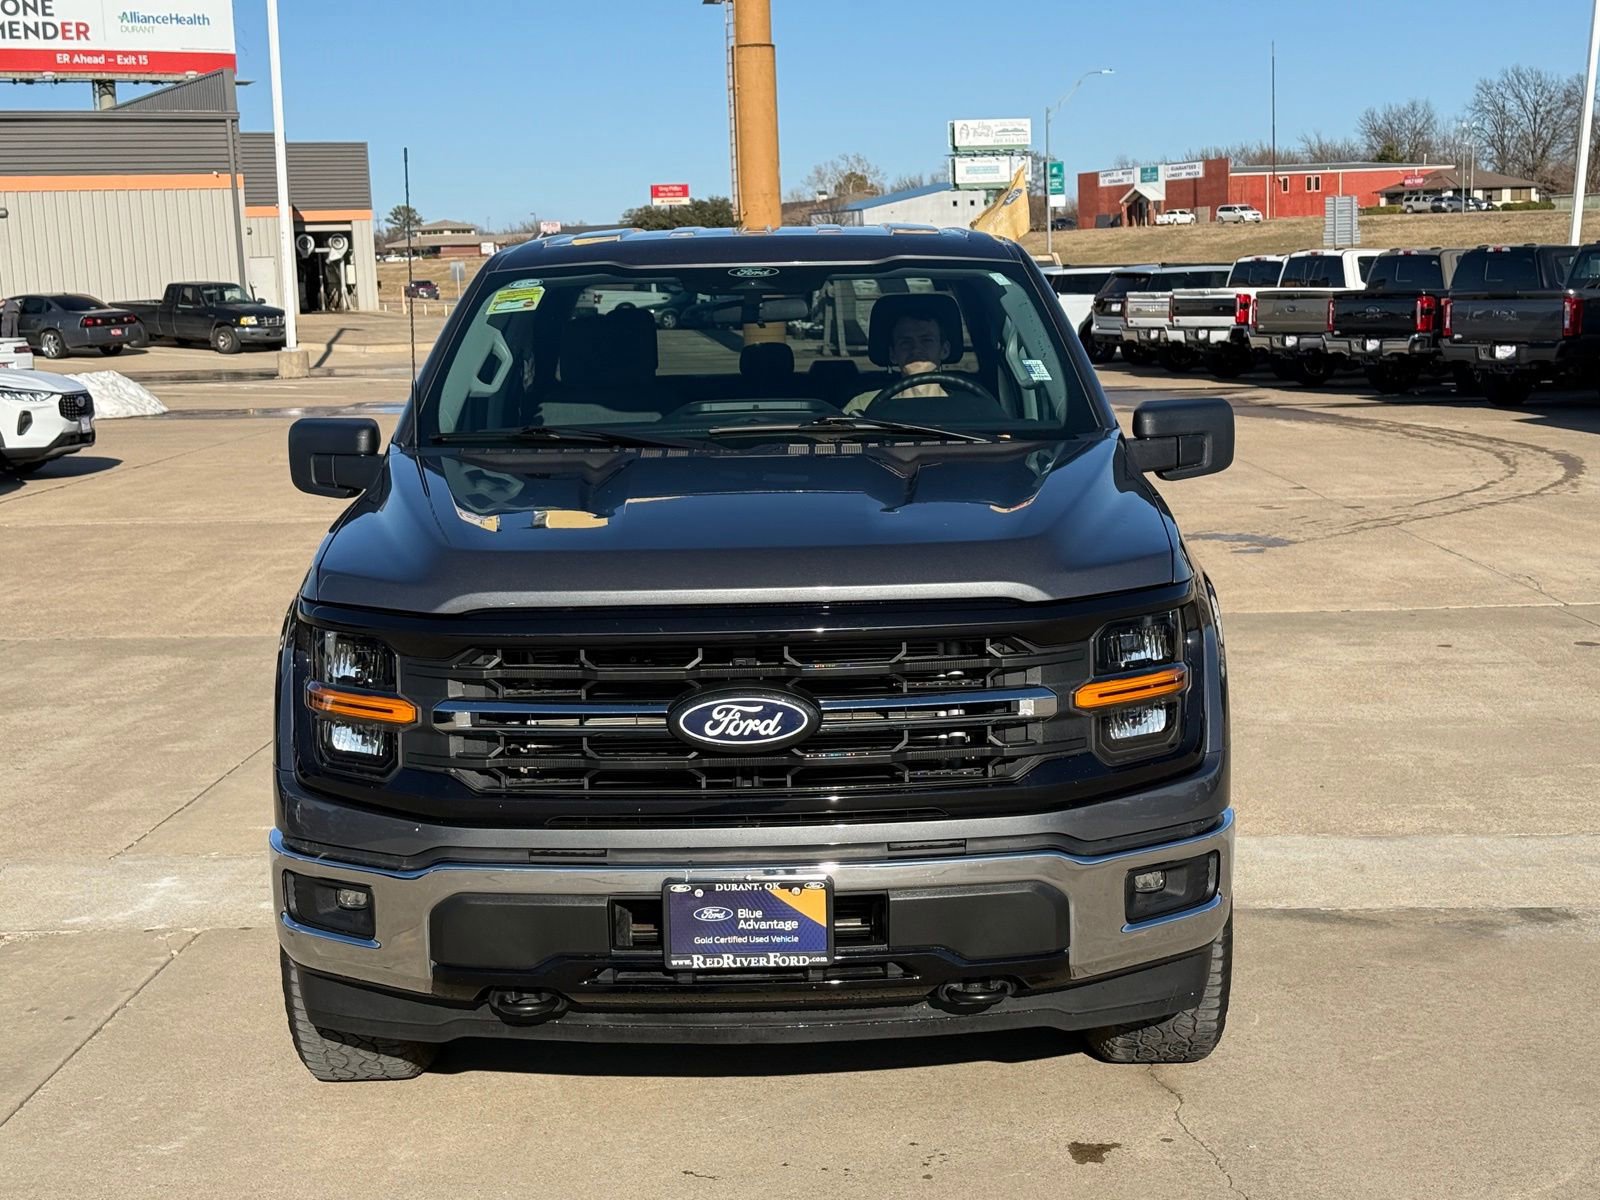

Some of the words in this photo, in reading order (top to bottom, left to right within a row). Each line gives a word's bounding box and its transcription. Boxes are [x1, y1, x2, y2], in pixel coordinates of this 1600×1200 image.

[0, 0, 54, 16] ONE
[119, 11, 211, 26] AllianceHealth
[0, 21, 91, 41] ENDER
[120, 25, 156, 34] DURANT
[56, 54, 71, 64] ER
[72, 54, 106, 65] Ahead
[117, 55, 137, 65] Exit
[138, 56, 149, 65] 15
[704, 705, 784, 736] Ford
[715, 883, 762, 891] DURANT,
[701, 909, 726, 919] Ford
[737, 909, 763, 918] Blue
[737, 919, 799, 930] Advantage
[694, 936, 713, 944] Gold
[714, 936, 748, 944] Certified
[749, 935, 770, 943] Used
[771, 935, 799, 943] Vehicle
